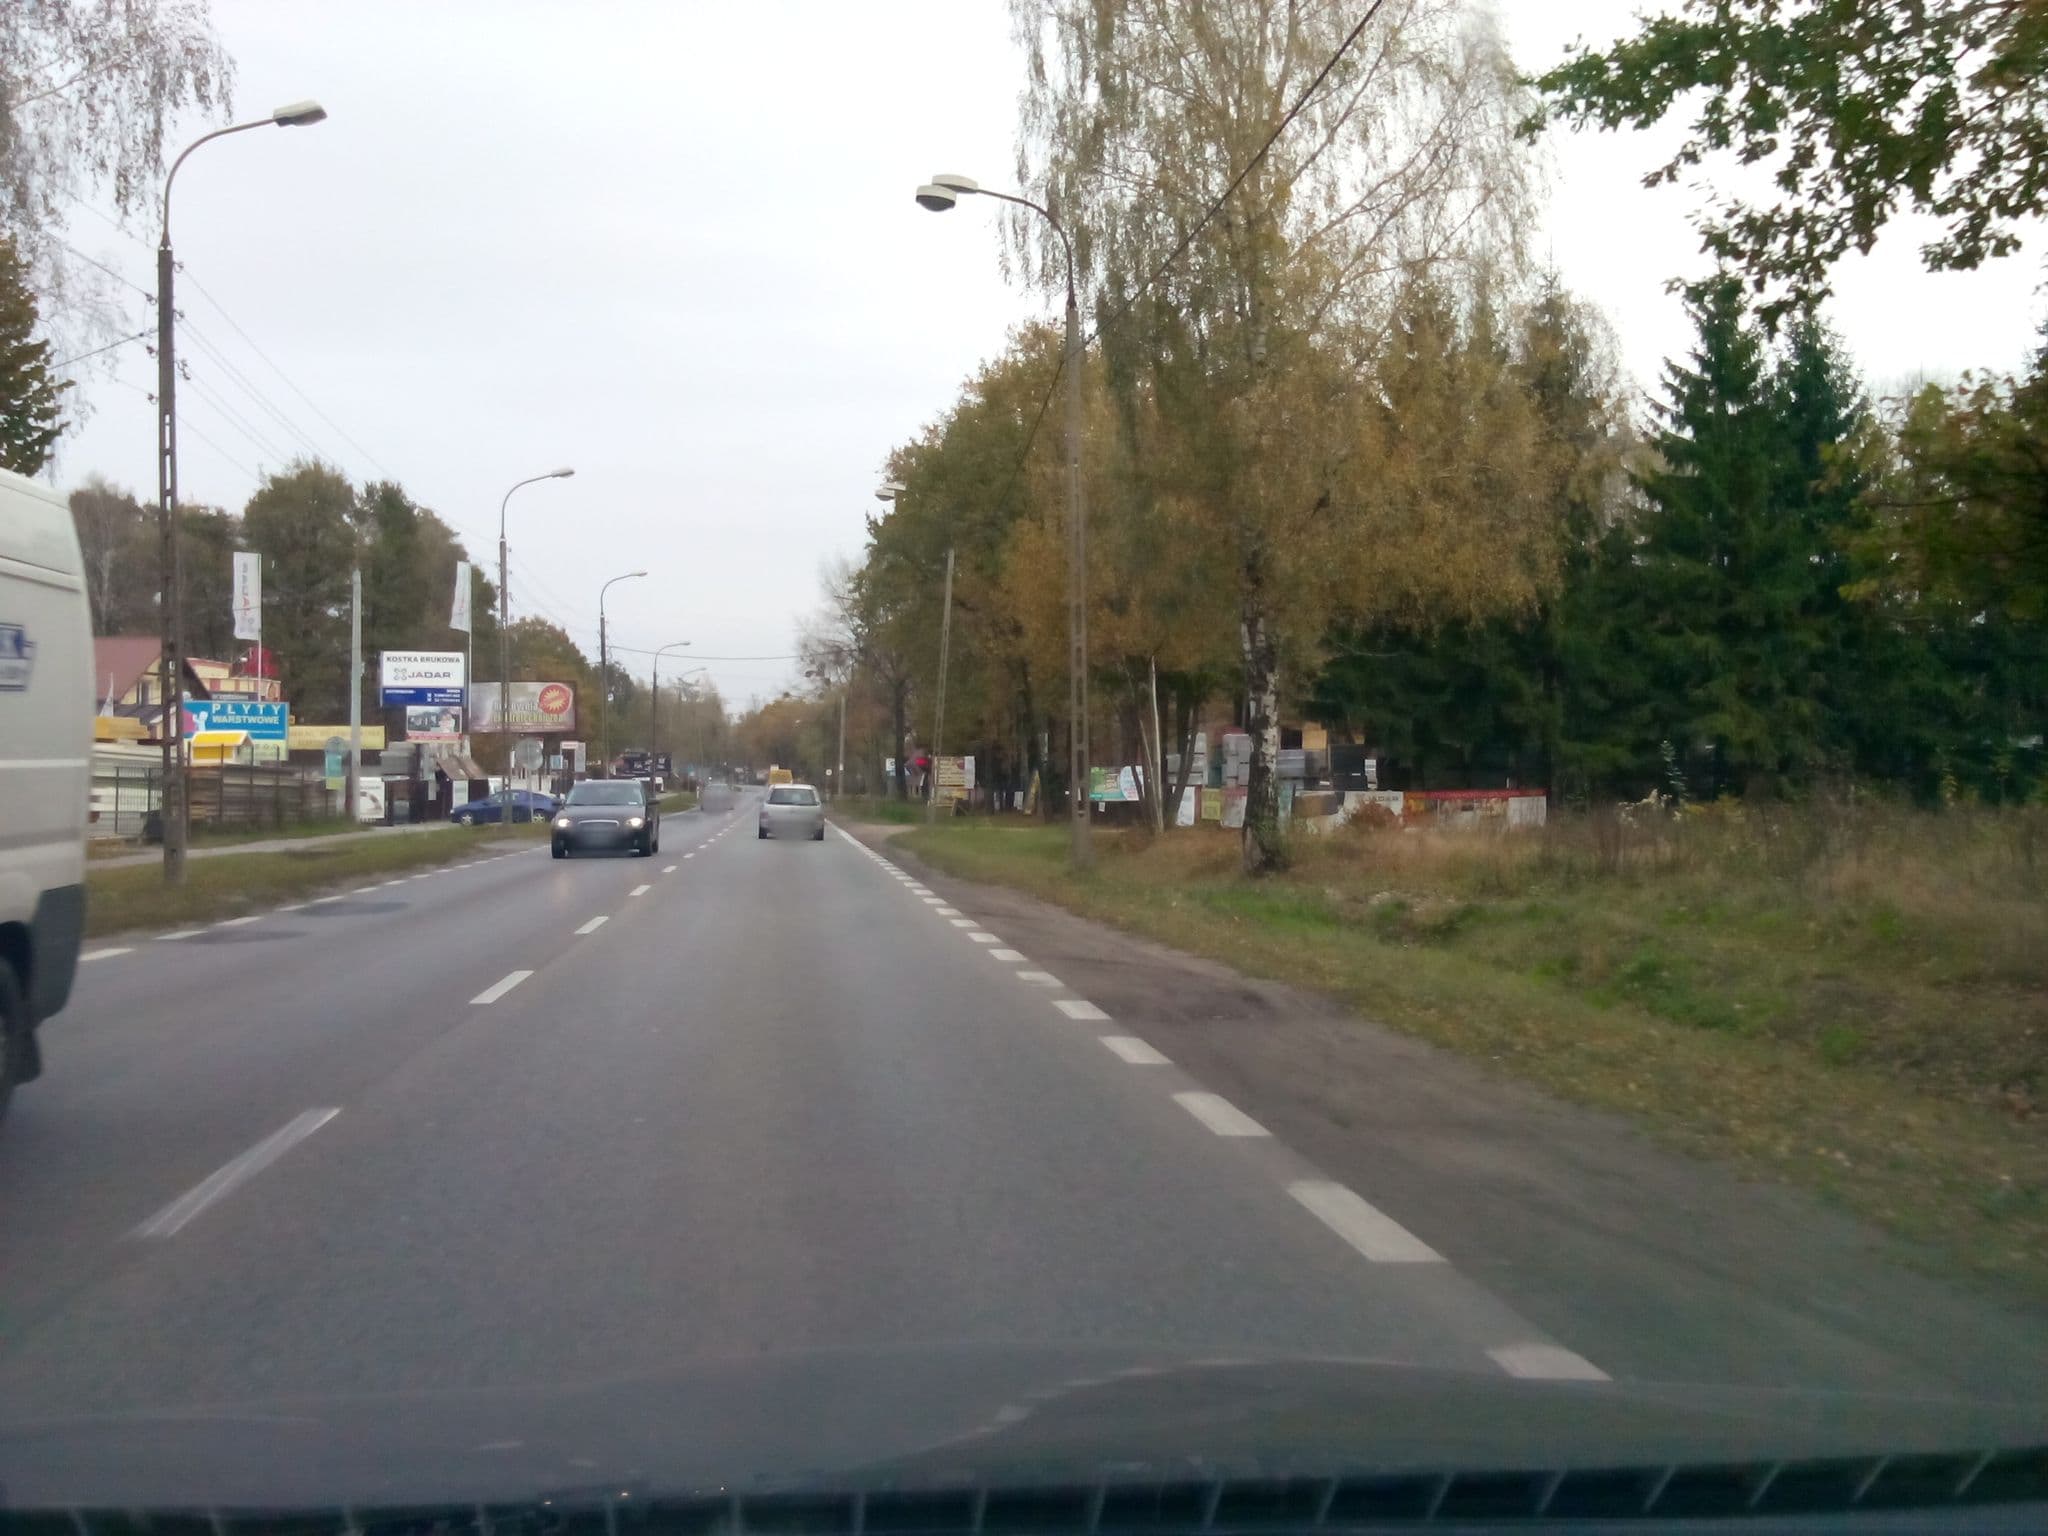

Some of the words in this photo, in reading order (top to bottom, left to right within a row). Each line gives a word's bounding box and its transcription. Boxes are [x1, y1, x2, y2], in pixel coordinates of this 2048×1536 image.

[420, 656, 460, 664] BRUKOWA
[408, 671, 451, 679] JADAR
[212, 715, 280, 725] WARSTWOWE
